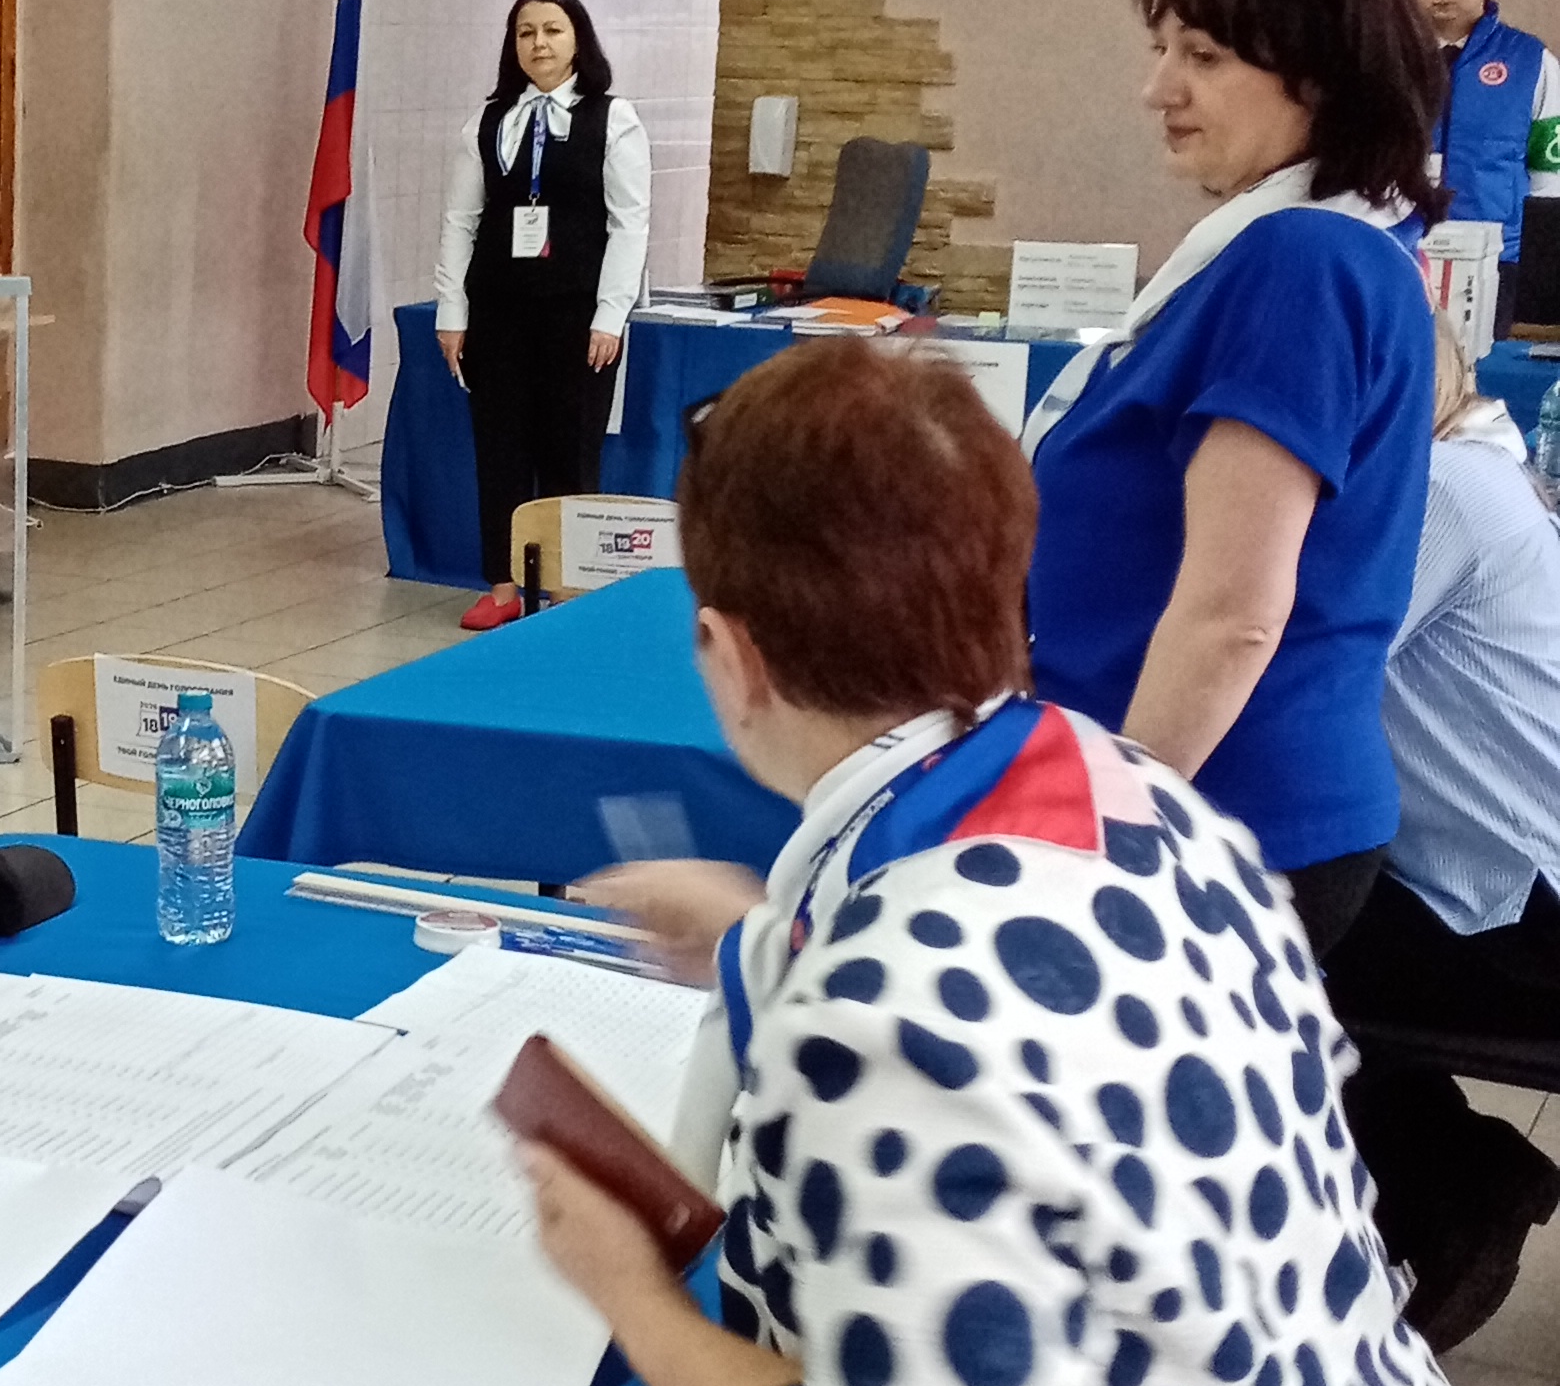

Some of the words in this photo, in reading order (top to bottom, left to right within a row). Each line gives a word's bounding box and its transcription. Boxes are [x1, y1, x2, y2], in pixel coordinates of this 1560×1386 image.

[600, 543, 614, 554] 18
[632, 533, 651, 546] 20
[142, 717, 159, 733] 18
